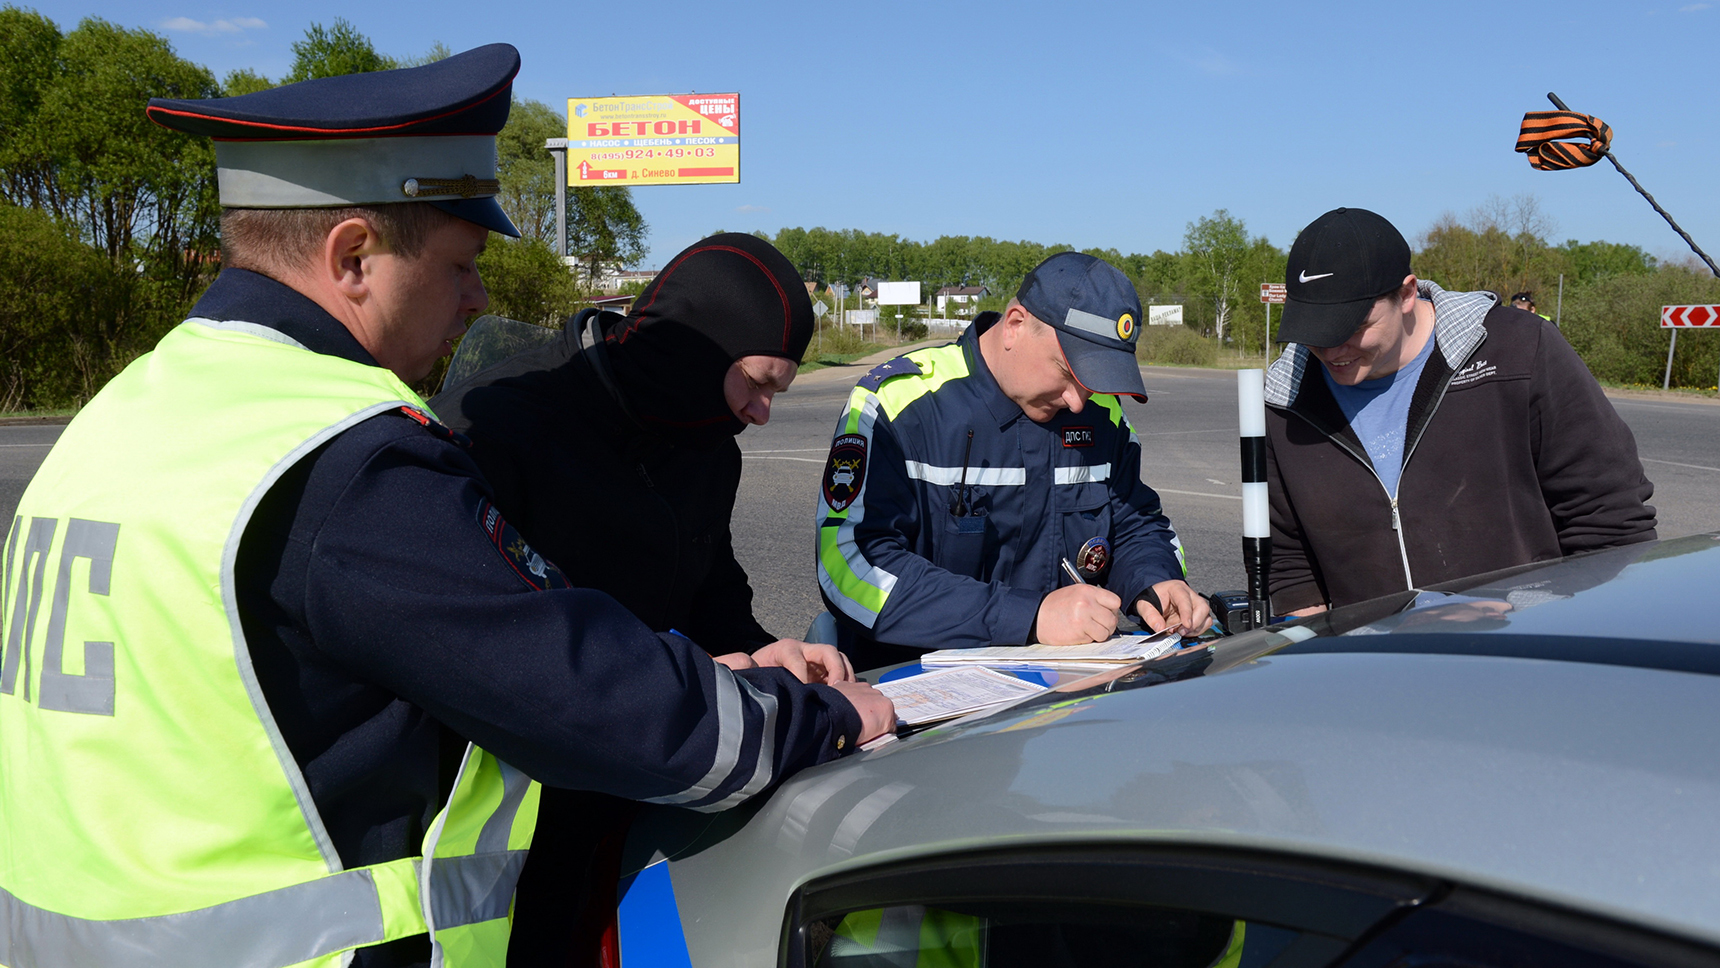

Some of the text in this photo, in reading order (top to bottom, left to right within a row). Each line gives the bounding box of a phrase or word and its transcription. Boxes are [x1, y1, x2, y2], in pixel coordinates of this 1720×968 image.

[593, 101, 674, 113] БетонТрансСтрой
[700, 104, 735, 115] ЦЕНЫ
[600, 112, 667, 120] www.betontransstroy.ru
[587, 120, 701, 137] БЕТОН
[633, 138, 672, 147] ЩЕБЕНЬ
[642, 168, 675, 178] Синево
[835, 437, 865, 448] ПОЛИЦИЯ
[1065, 431, 1081, 443] ДПС
[831, 498, 847, 511] МВД
